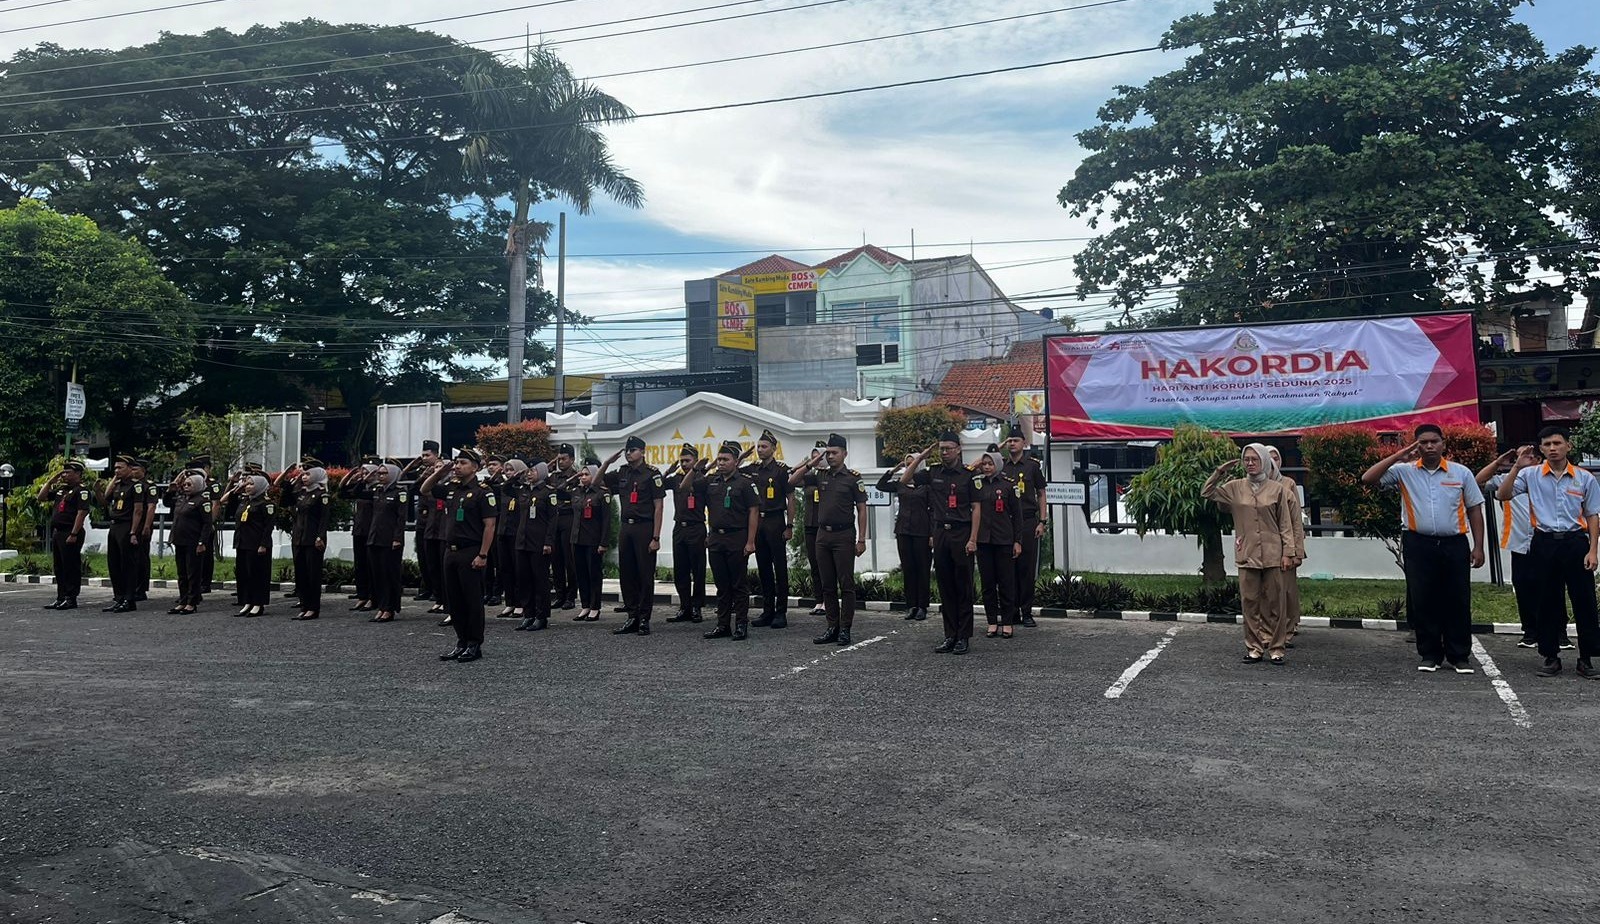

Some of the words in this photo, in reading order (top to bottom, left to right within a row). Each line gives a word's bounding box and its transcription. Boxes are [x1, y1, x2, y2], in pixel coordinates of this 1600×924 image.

[791, 272, 808, 281] BOS
[788, 281, 813, 290] CEMPE
[724, 301, 739, 315] BOS
[721, 318, 743, 331] CEMPE
[1141, 350, 1369, 380] HAKORDIA
[1182, 384, 1208, 392] ANTI
[1212, 382, 1263, 391] KORUPSI
[1267, 380, 1320, 388] SEDUNIA
[1324, 378, 1352, 386] 2025
[1192, 395, 1228, 403] Korupsi
[1259, 391, 1320, 400] Kemakmuran
[645, 444, 665, 465] TRI
